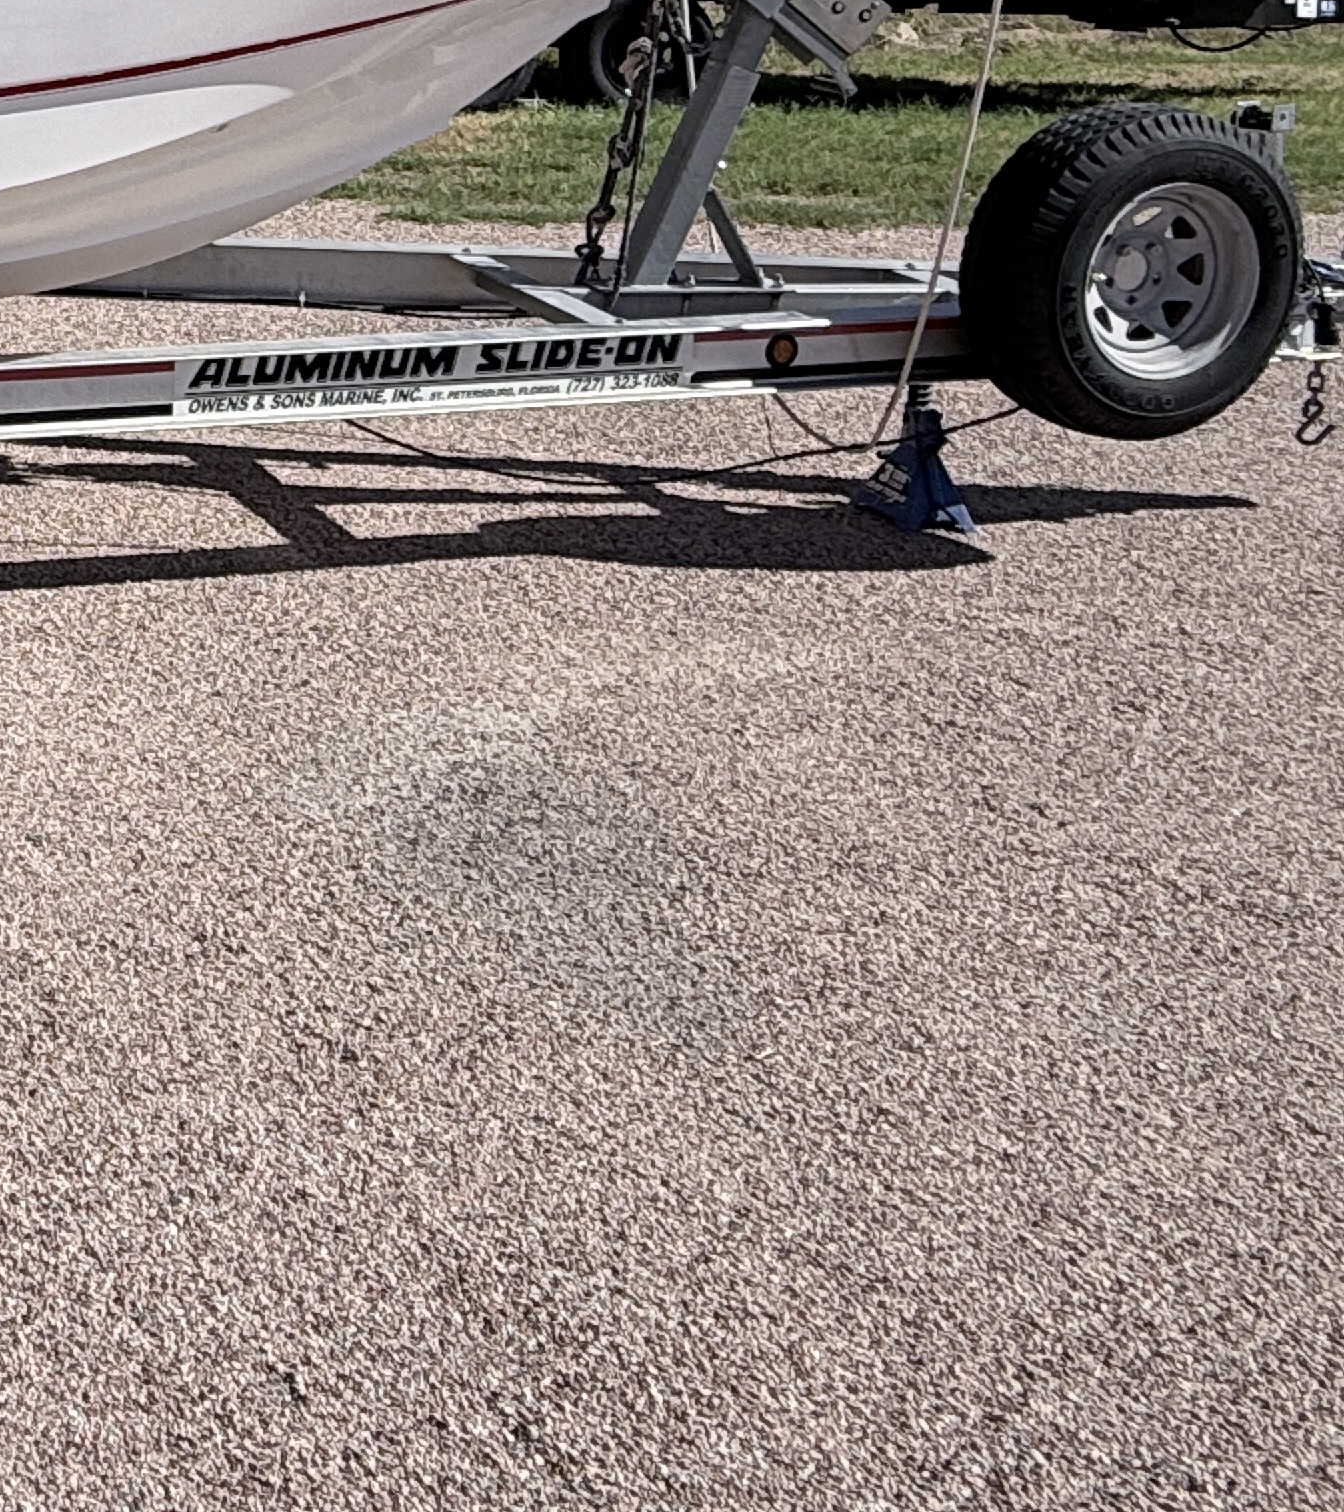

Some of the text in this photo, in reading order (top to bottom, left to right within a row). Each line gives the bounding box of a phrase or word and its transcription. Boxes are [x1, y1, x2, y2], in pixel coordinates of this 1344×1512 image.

[188, 334, 683, 390] ALUMINUM SLIDE-ON
[188, 393, 250, 414] OWENS
[252, 393, 267, 411] &
[271, 391, 316, 410] SONS
[320, 388, 387, 408] MARINE,
[391, 386, 424, 404] INC.
[566, 374, 606, 395] (727)
